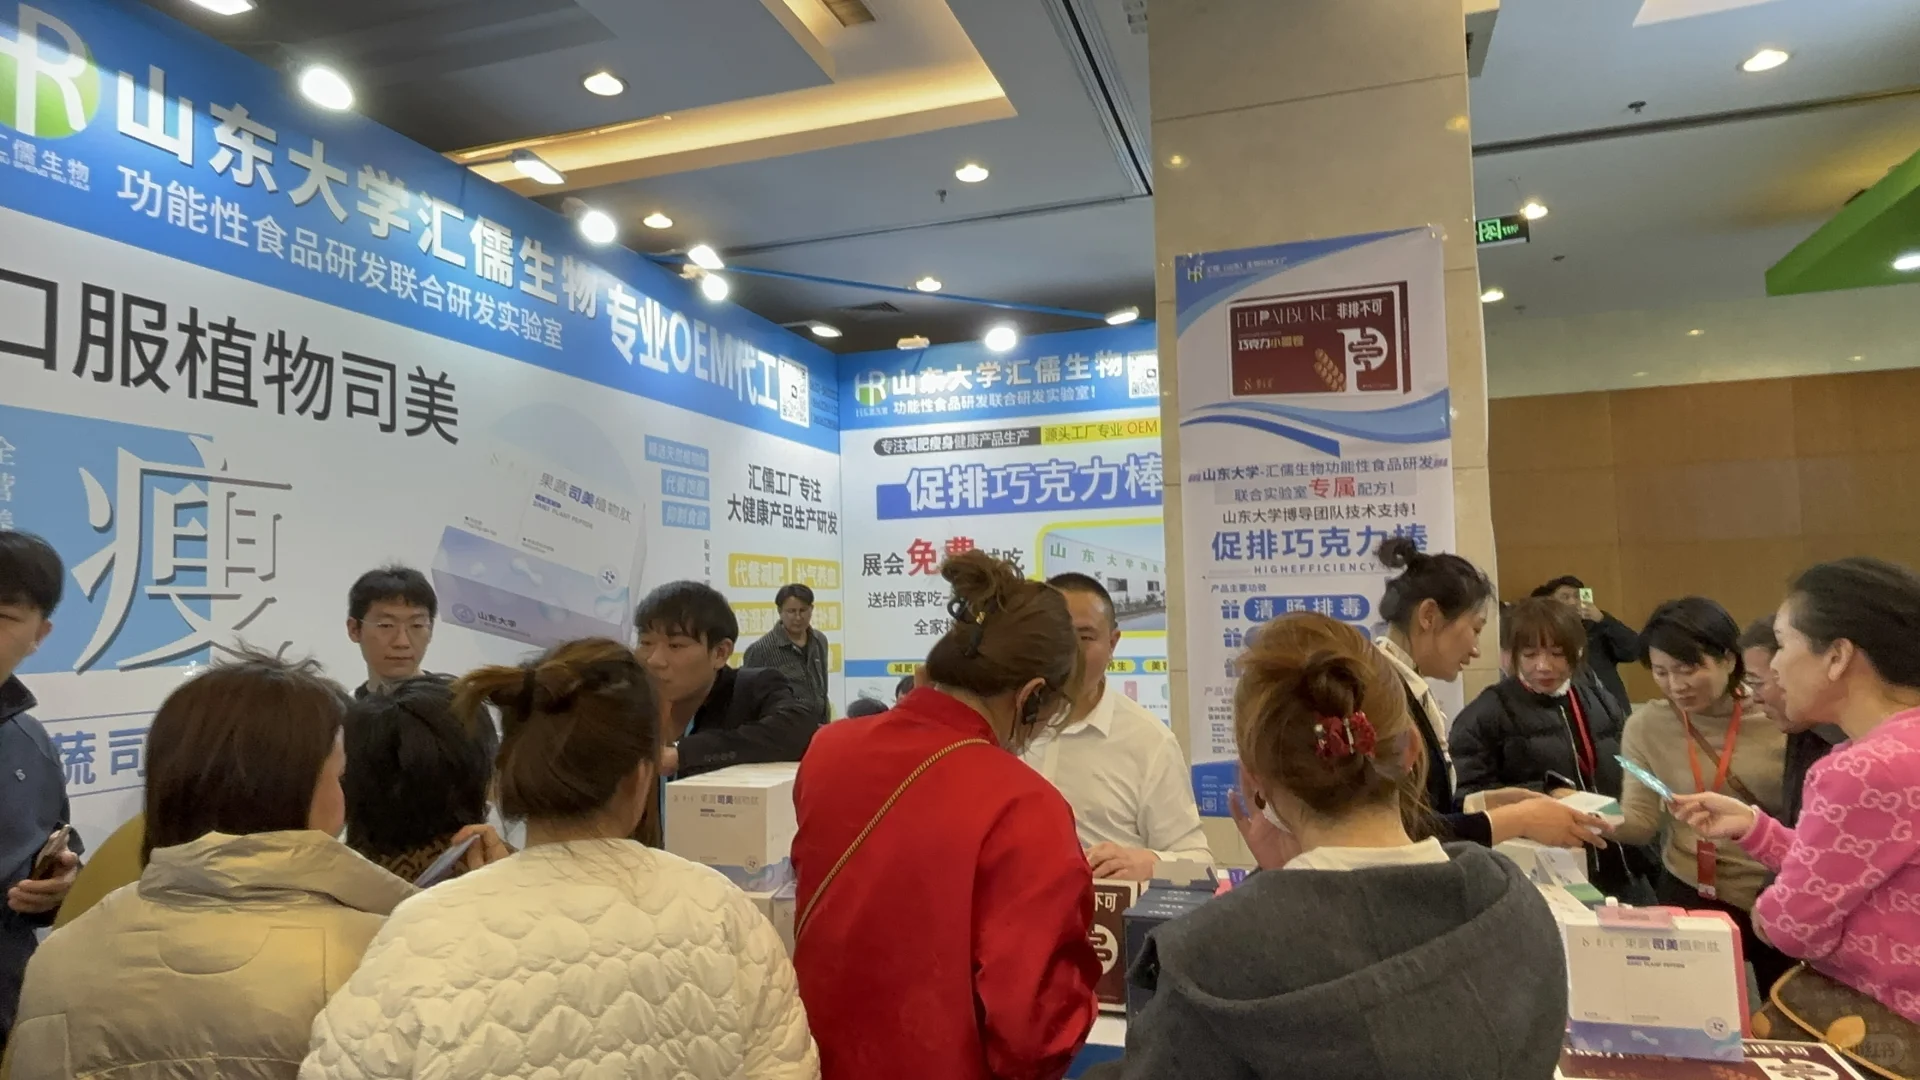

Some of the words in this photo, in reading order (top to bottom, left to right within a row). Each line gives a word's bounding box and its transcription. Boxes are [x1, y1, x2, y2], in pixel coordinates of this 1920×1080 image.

[0, 134, 90, 184] 儒生物
[116, 64, 598, 321] 山东大学汇儒生物
[606, 283, 777, 411] 专业OEM代工
[116, 164, 564, 350] 功能性食品研发联合研发实验室
[1336, 298, 1383, 320] 非排不可
[892, 350, 1123, 396] 山东大学汇儒生物
[881, 428, 1030, 456] 专注减肥瘦身健康产品生产
[1044, 418, 1124, 443] 源头工厂专业
[1126, 419, 1158, 436] OEM
[748, 463, 822, 504] 汇儒工厂专注
[727, 493, 838, 536] 大健康产品生产研发
[477, 609, 517, 629] 山东大学
